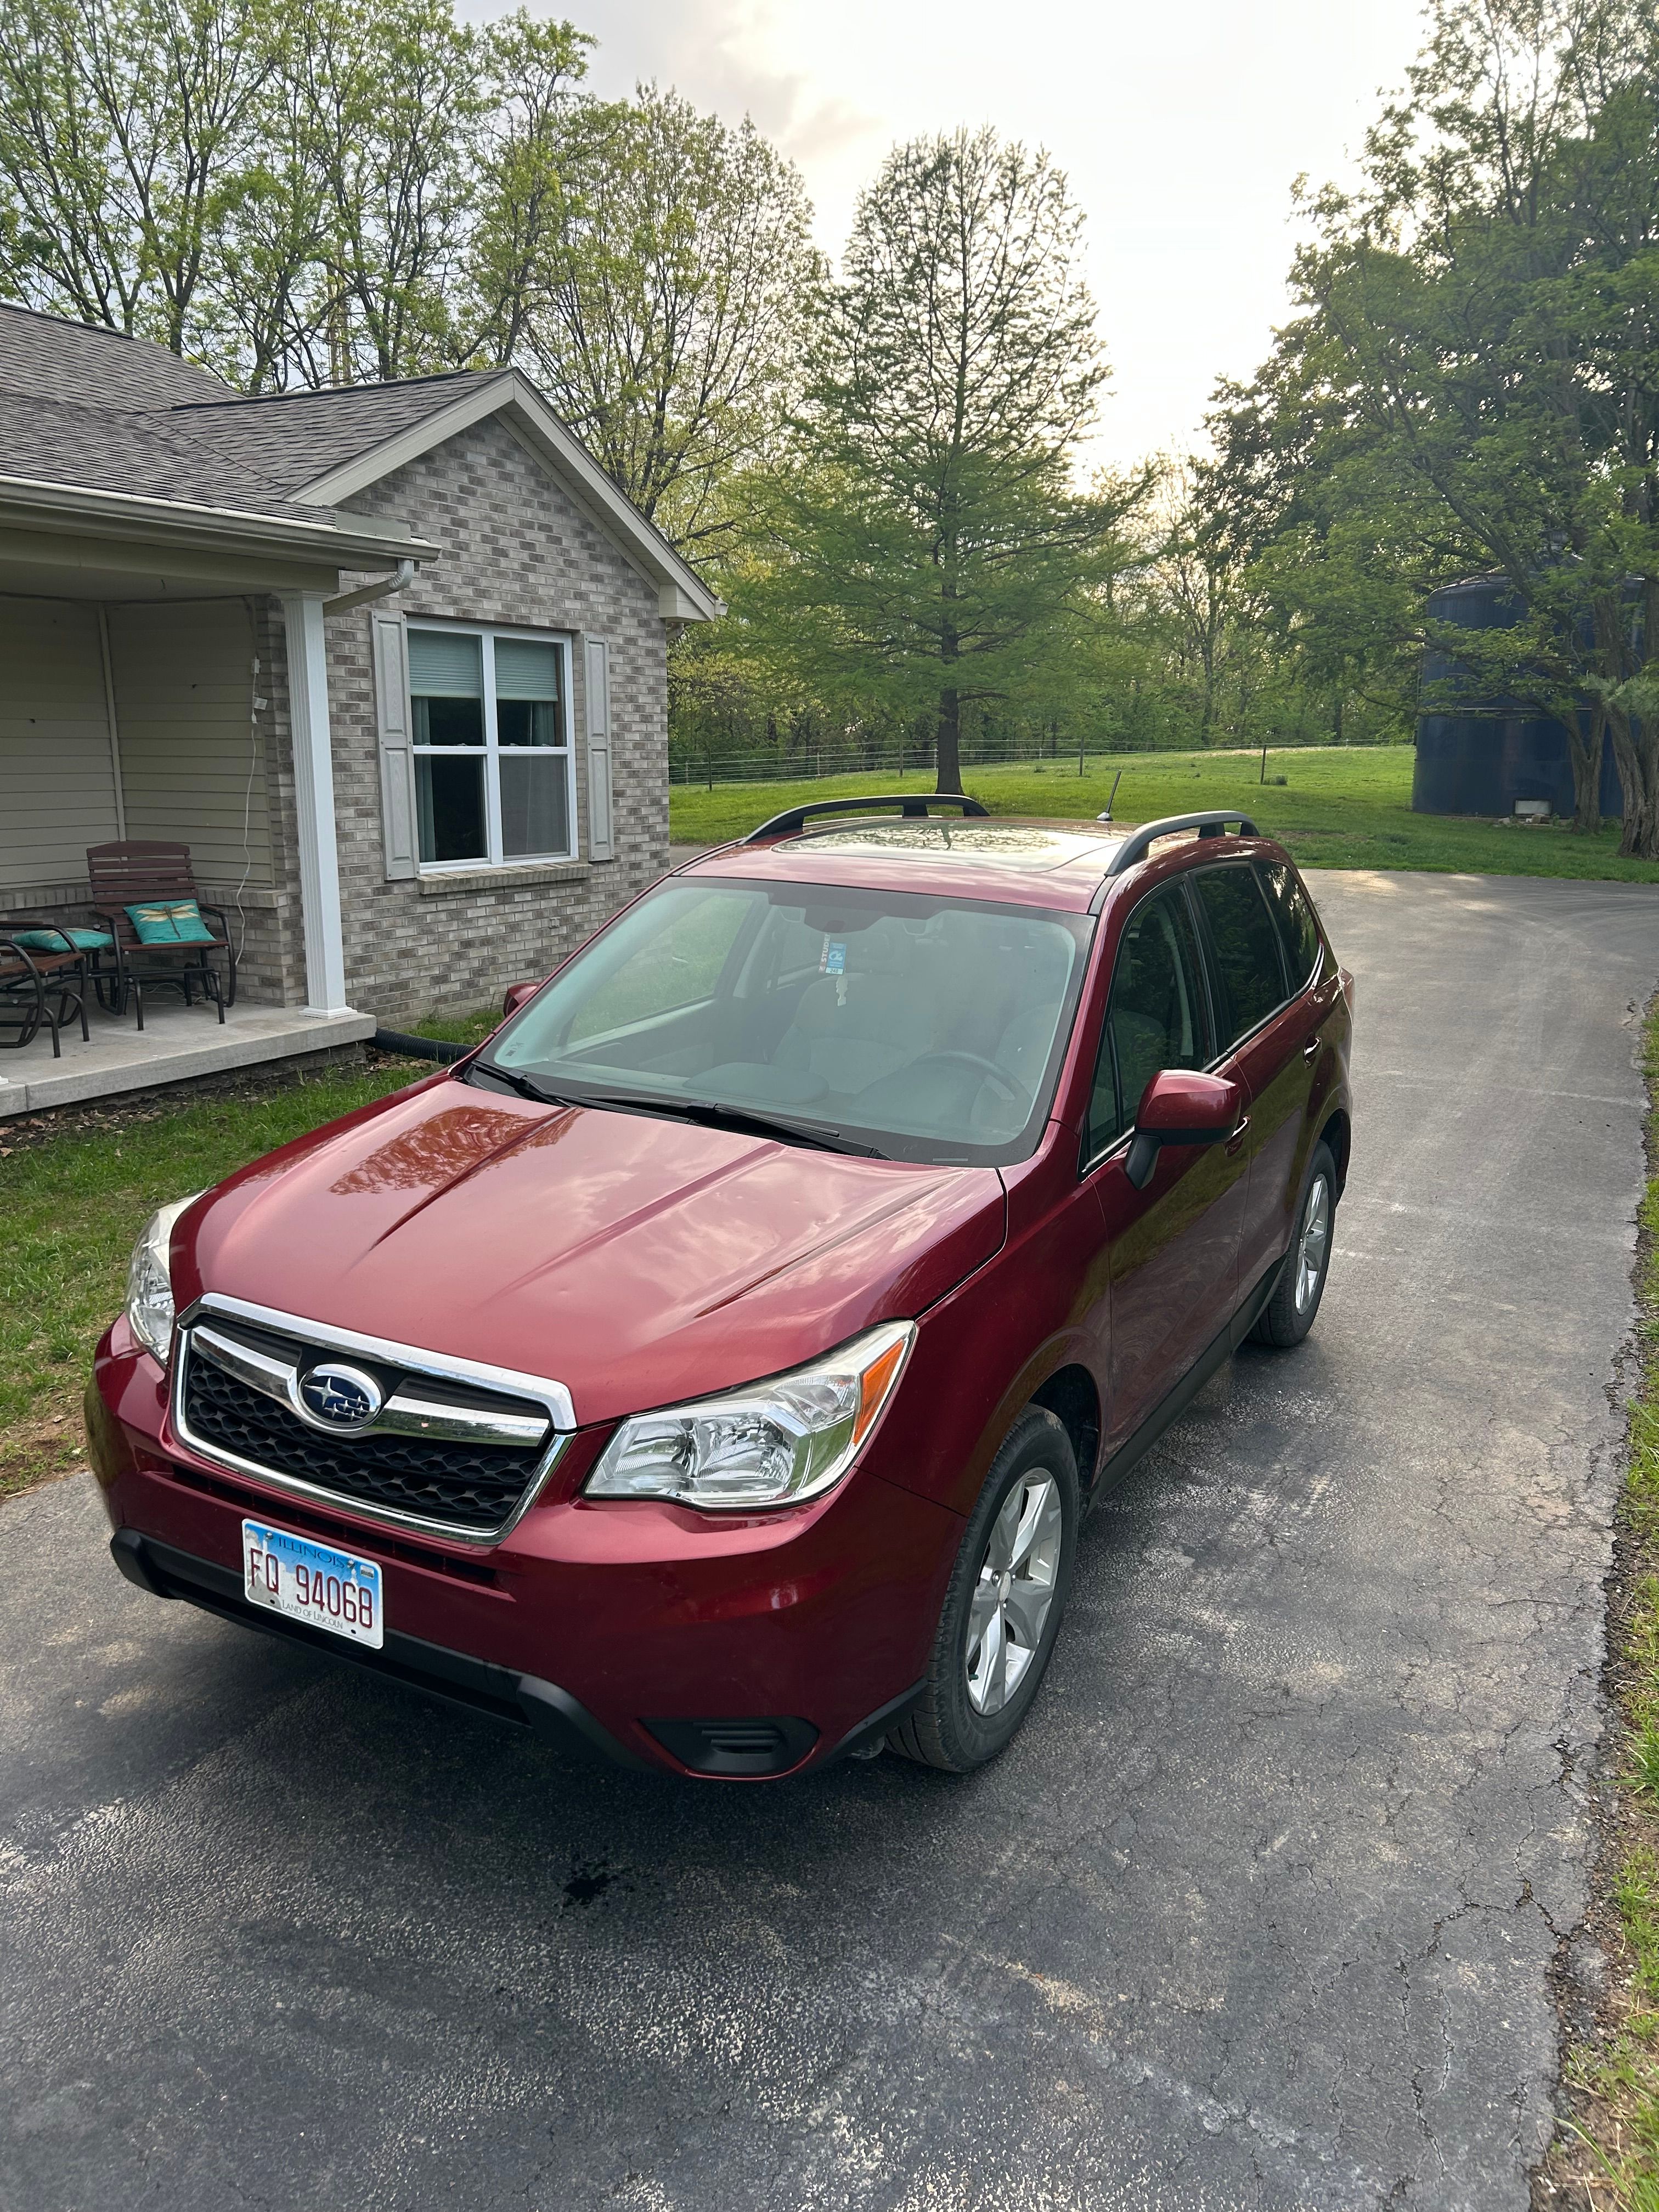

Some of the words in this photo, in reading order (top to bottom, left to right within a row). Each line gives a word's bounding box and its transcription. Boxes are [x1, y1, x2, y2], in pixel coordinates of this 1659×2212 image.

[279, 1537, 345, 1568] ILLINOIS
[251, 1548, 279, 1595] FQ
[296, 1564, 373, 1629] 94068
[282, 1600, 302, 1613] LAND
[303, 1609, 312, 1617] OF
[314, 1611, 343, 1629] LINCOLN
